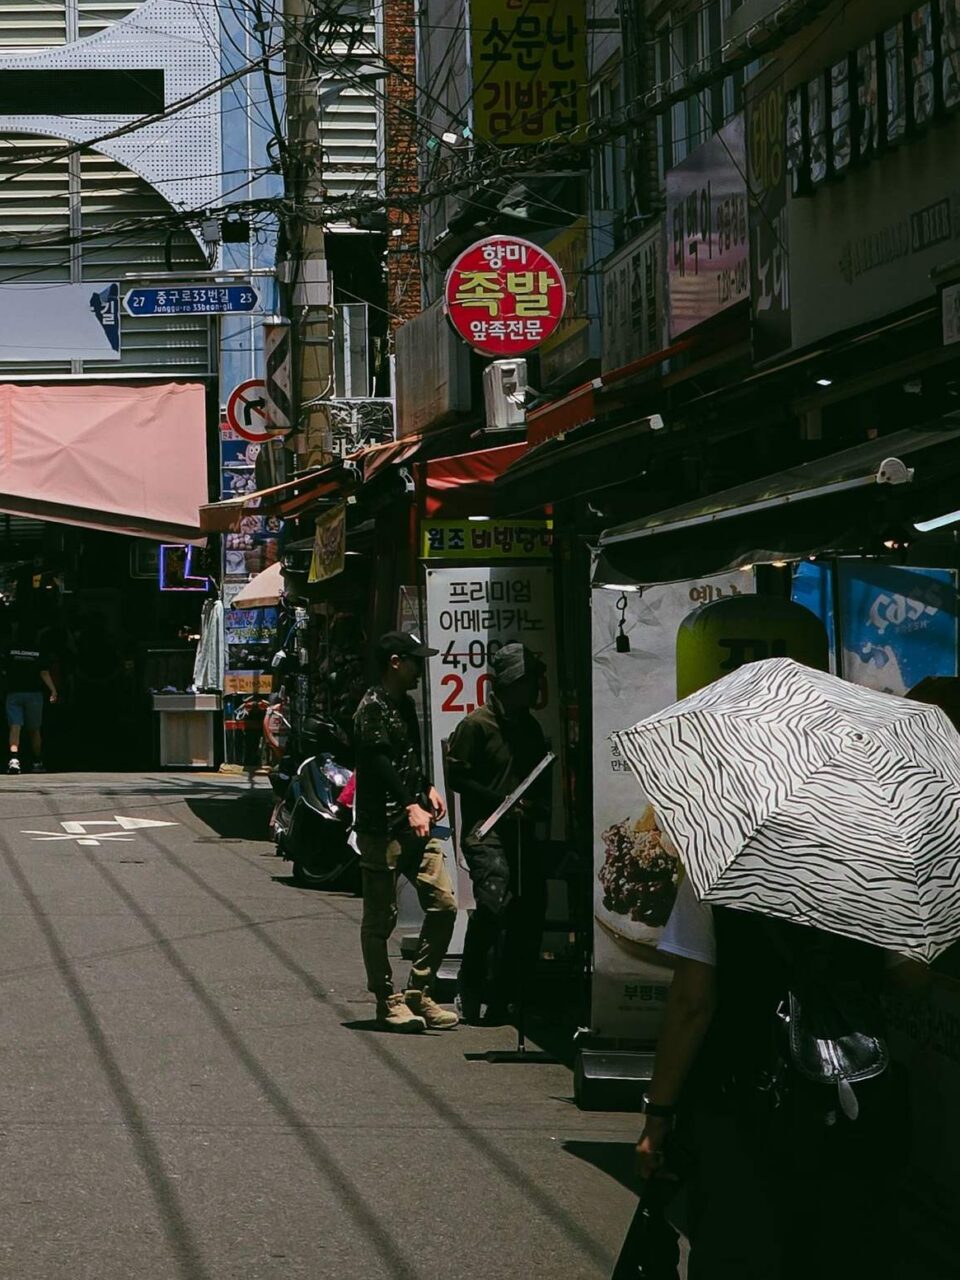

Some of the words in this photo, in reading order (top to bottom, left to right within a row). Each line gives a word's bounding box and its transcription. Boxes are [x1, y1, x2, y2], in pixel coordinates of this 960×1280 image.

[480, 15, 578, 71] 소문난
[482, 79, 578, 136] 김밥집
[481, 245, 528, 269] 향미
[132, 297, 146, 307] 27
[155, 288, 230, 305] 중구로33번길
[240, 293, 253, 304] 23
[455, 271, 556, 318] 족발
[100, 301, 115, 325] 길
[153, 305, 192, 313] Junggu-ro
[469, 320, 544, 341] 앞족전문
[428, 527, 465, 551] 원조
[449, 580, 531, 604] 프리미엄
[439, 609, 545, 632] 아메리카노
